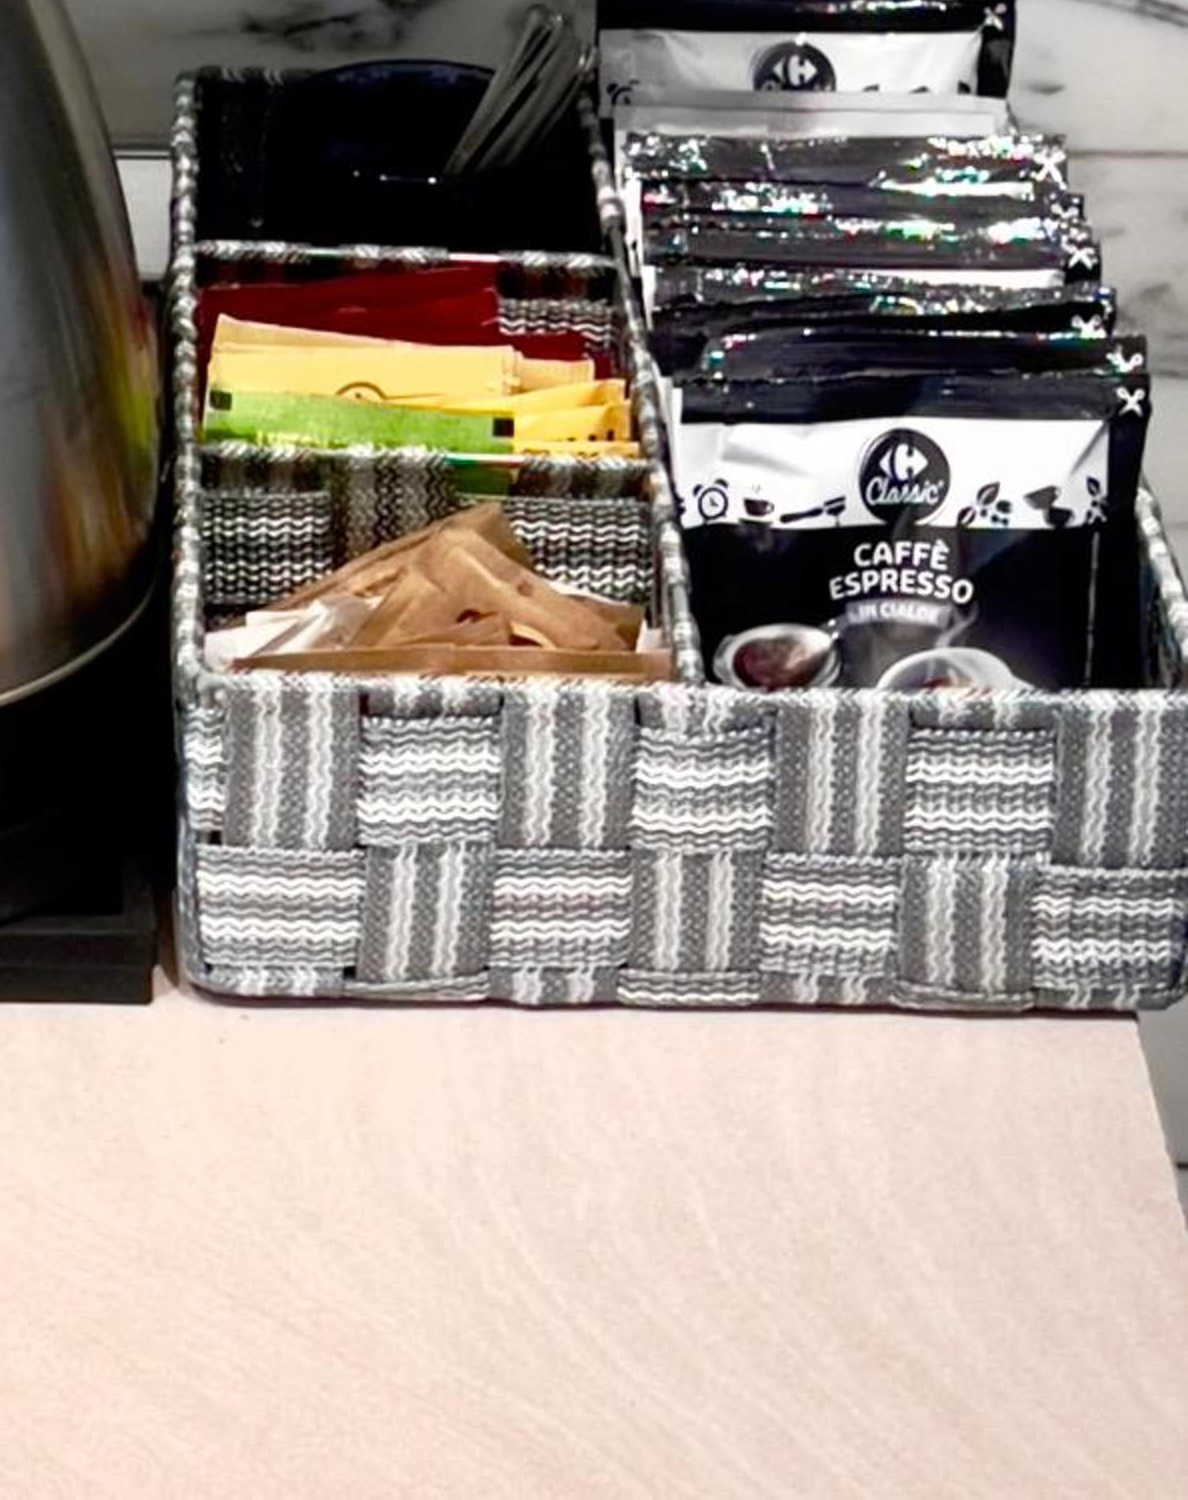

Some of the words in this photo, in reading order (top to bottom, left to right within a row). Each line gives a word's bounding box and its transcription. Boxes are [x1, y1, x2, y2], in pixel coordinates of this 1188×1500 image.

[865, 476, 940, 506] Classic
[853, 538, 950, 571] CAFFÈ
[829, 568, 974, 604] ESPRESSO
